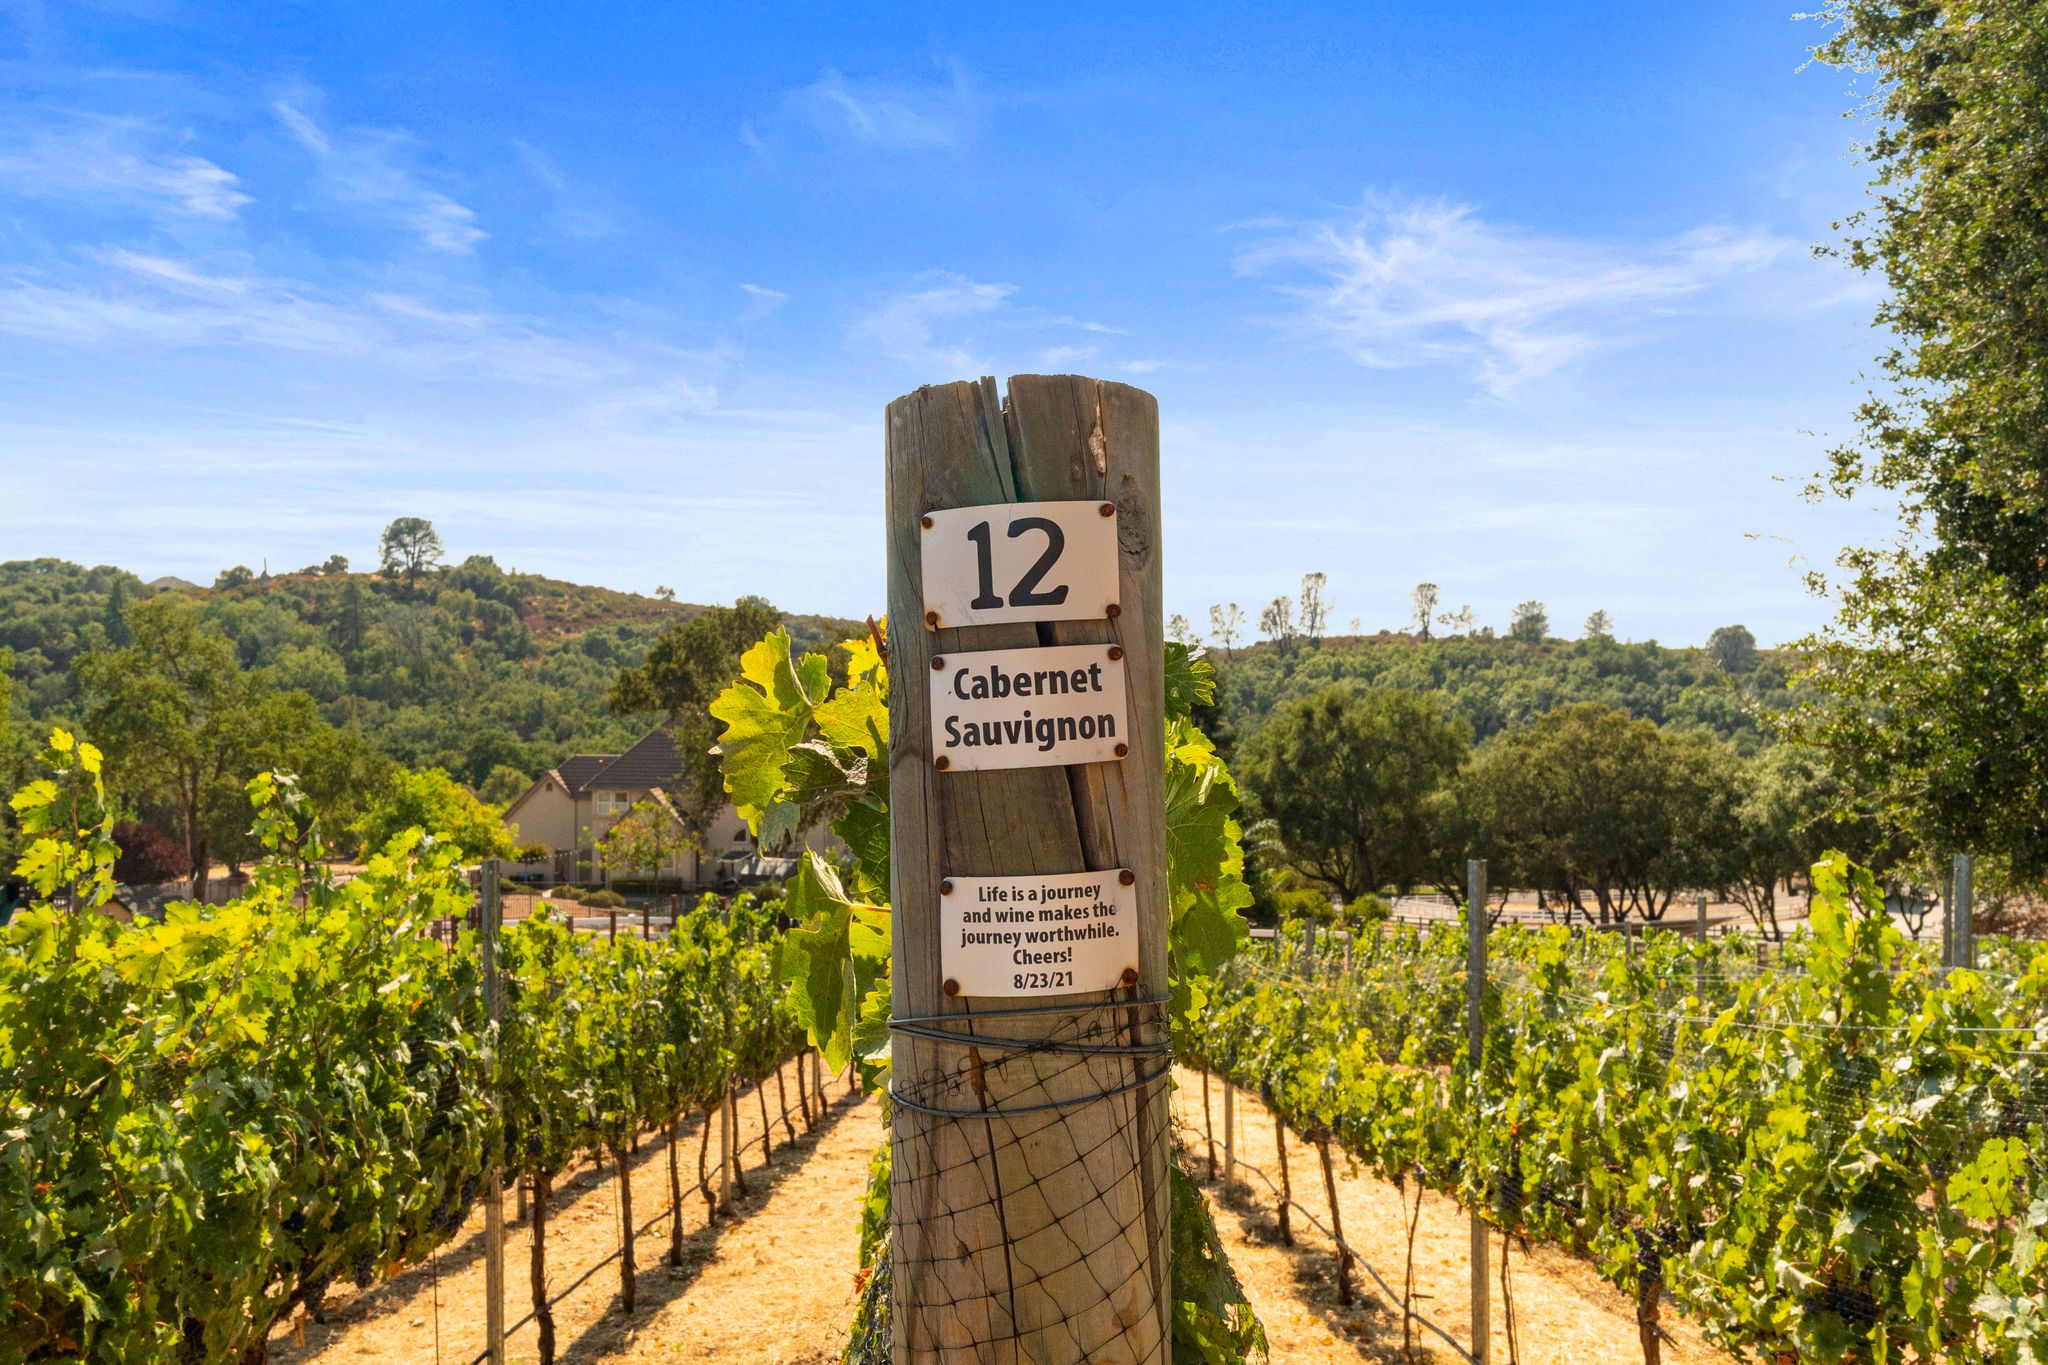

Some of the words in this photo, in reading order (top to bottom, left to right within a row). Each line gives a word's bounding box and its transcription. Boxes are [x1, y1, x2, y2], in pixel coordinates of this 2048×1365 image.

[967, 517, 1069, 610] 12
[953, 662, 1103, 701] Cabernet
[944, 710, 1116, 752] Sauvignon
[978, 886, 1008, 902] Life
[1012, 886, 1024, 902] is
[1028, 889, 1037, 901] a
[1039, 884, 1101, 905] journey
[962, 907, 992, 923] and
[994, 907, 1035, 923] wine
[1039, 904, 1090, 922] makes
[1092, 901, 1118, 917] the
[960, 927, 1022, 949] journey
[1024, 922, 1120, 944] worthwhile.
[1012, 946, 1073, 966] Cheers!
[1013, 970, 1073, 990] 8/23/21
